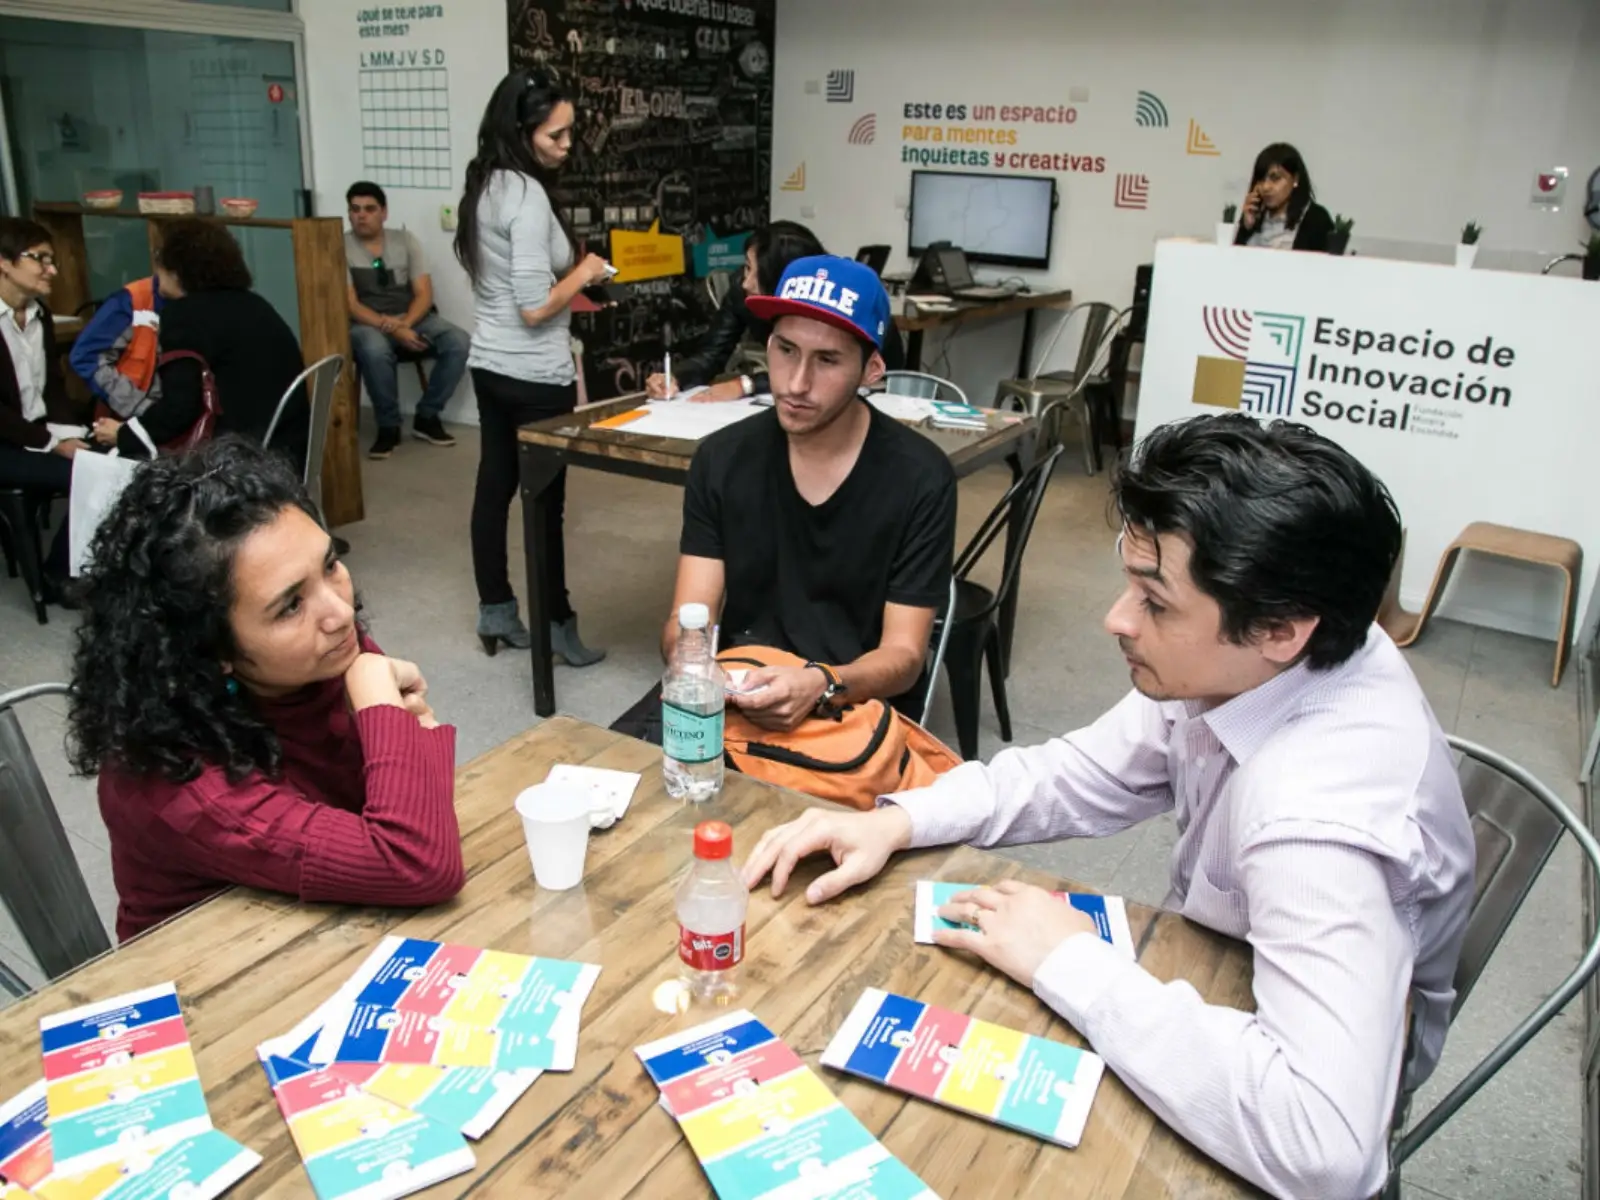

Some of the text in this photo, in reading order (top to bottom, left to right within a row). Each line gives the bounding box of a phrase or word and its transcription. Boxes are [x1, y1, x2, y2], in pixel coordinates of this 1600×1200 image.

[382, 8, 394, 21] se
[418, 5, 443, 20] para
[359, 23, 409, 38] este mes?
[904, 102, 1077, 124] Este es un espacio
[902, 124, 1017, 145] para mentes
[902, 145, 1106, 173] inquietas y creativas
[780, 275, 859, 316] CHILE
[1313, 317, 1515, 368] Espacio de
[1307, 354, 1512, 407] Innovación
[1301, 390, 1410, 431] Social
